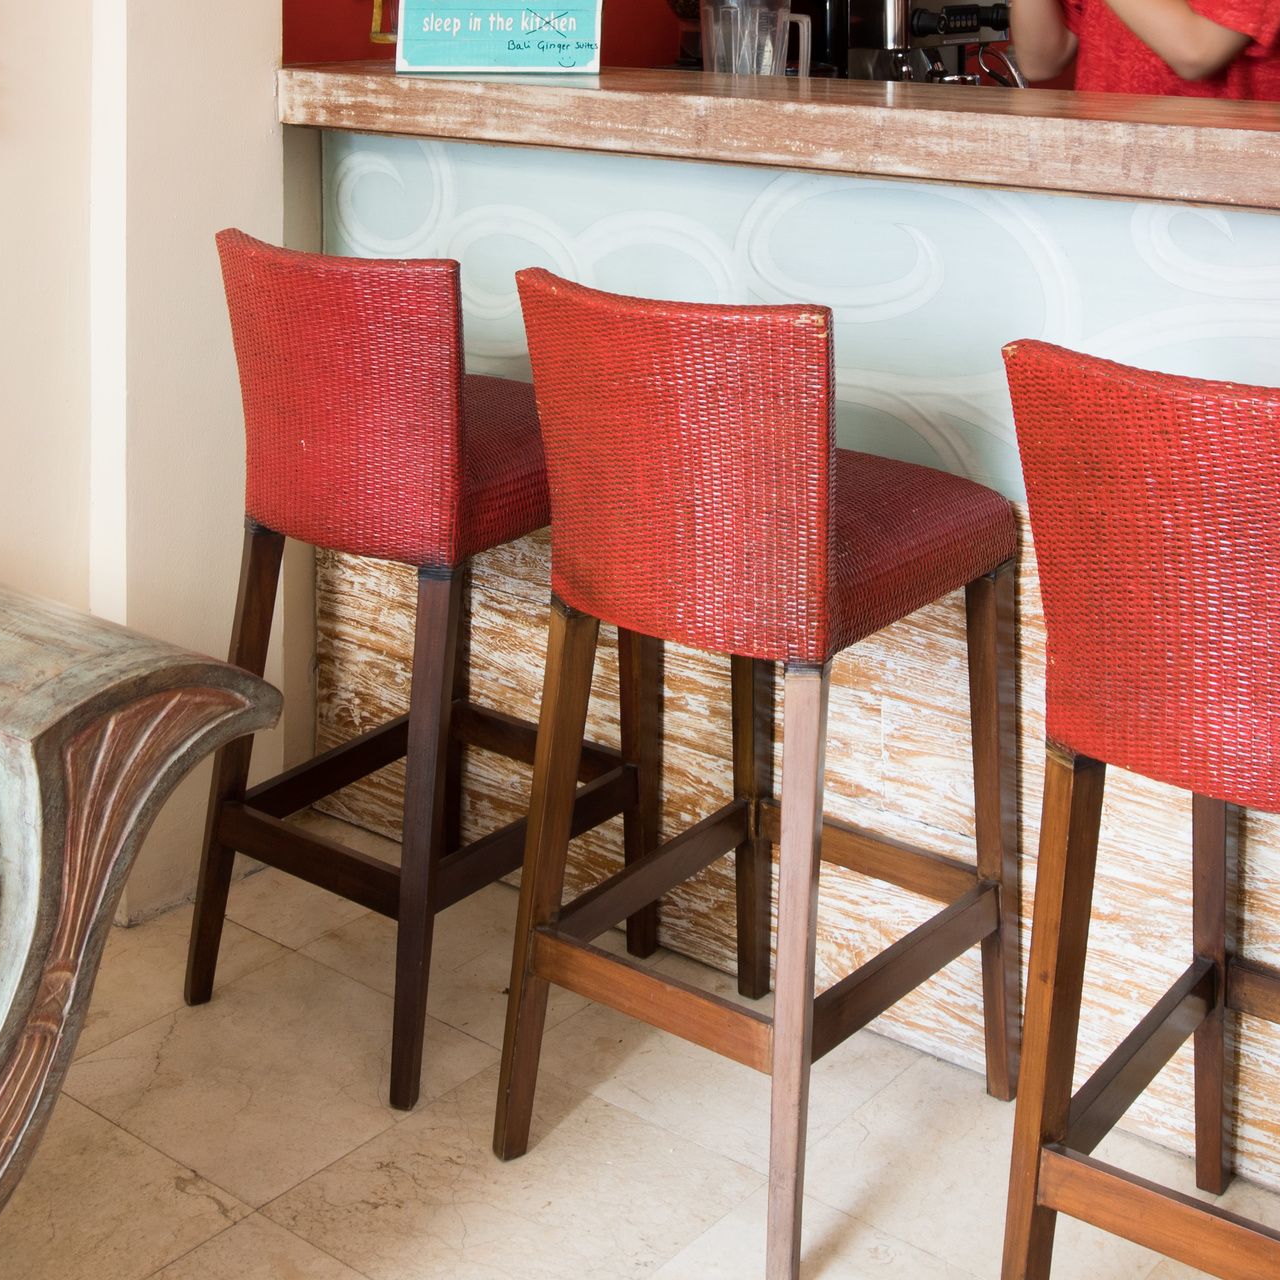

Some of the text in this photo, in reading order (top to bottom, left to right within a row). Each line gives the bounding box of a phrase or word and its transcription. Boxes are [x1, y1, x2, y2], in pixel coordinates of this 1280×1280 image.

[423, 10, 577, 37] sleep in the kitchen
[508, 40, 531, 51] Bali
[537, 41, 571, 54] Ginger
